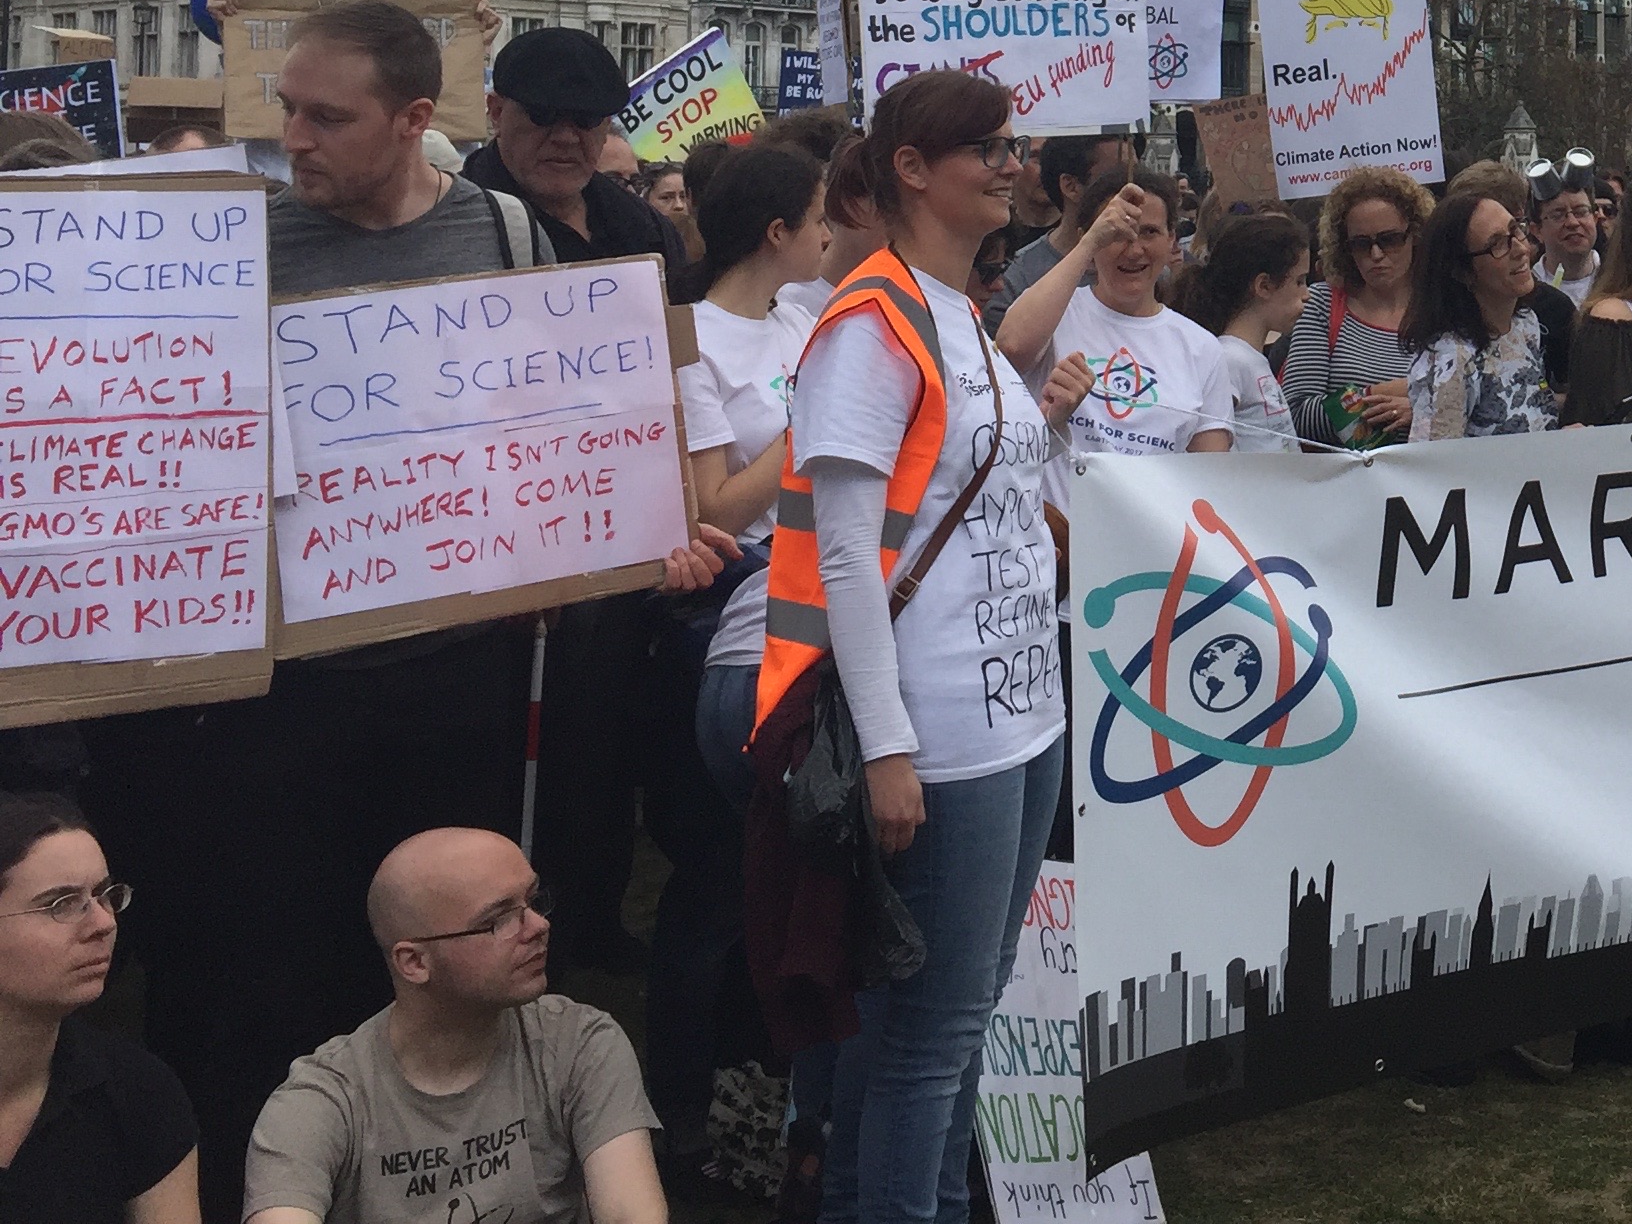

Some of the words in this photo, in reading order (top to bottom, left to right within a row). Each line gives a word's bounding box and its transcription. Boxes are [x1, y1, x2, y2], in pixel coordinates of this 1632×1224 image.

[867, 14, 916, 43] the
[921, 3, 1111, 43] SHOULDERS
[1115, 12, 1136, 33] of
[1146, 5, 1178, 25] BAL
[617, 95, 654, 134] BE
[653, 48, 724, 105] COOL
[1011, 74, 1046, 116] EU
[1048, 39, 1116, 99] funding
[1272, 58, 1338, 86] Real.
[0, 80, 102, 114] CIENCE
[656, 87, 718, 144] STOP
[1275, 146, 1335, 167] Climate
[1339, 138, 1392, 160] Action
[1397, 134, 1438, 154] Now!
[192, 206, 248, 243] UP
[0, 261, 55, 295] OR
[84, 258, 257, 294] SCIENCE
[276, 293, 513, 366] STAND
[544, 277, 619, 319] UP
[0, 330, 216, 376] EVOLUTION
[434, 335, 655, 399] SCIENCE!
[48, 384, 74, 410] A
[99, 370, 235, 410] FACT!
[0, 429, 128, 464] LIMATE
[137, 421, 259, 454] CHANGE
[292, 449, 466, 508] REALITY
[485, 435, 571, 473] ISN'T
[576, 421, 667, 456] GOING
[1127, 432, 1176, 452] SCIENC
[0, 505, 106, 542] GMO'S
[112, 505, 173, 538] ARE
[181, 493, 267, 527] SAFE!
[302, 486, 490, 561] ANYWHERE!
[514, 468, 618, 507] COME
[0, 539, 250, 601] VACCINATE
[322, 556, 397, 601] AND
[425, 530, 517, 571] JOIN
[971, 542, 1042, 593] TEST
[980, 633, 1060, 729] REPE
[380, 1146, 450, 1177] NEVER
[462, 1118, 529, 1161] TRUST
[405, 1174, 437, 1199] AN
[449, 1150, 511, 1191] ATOM
[1002, 1179, 1066, 1219] think
